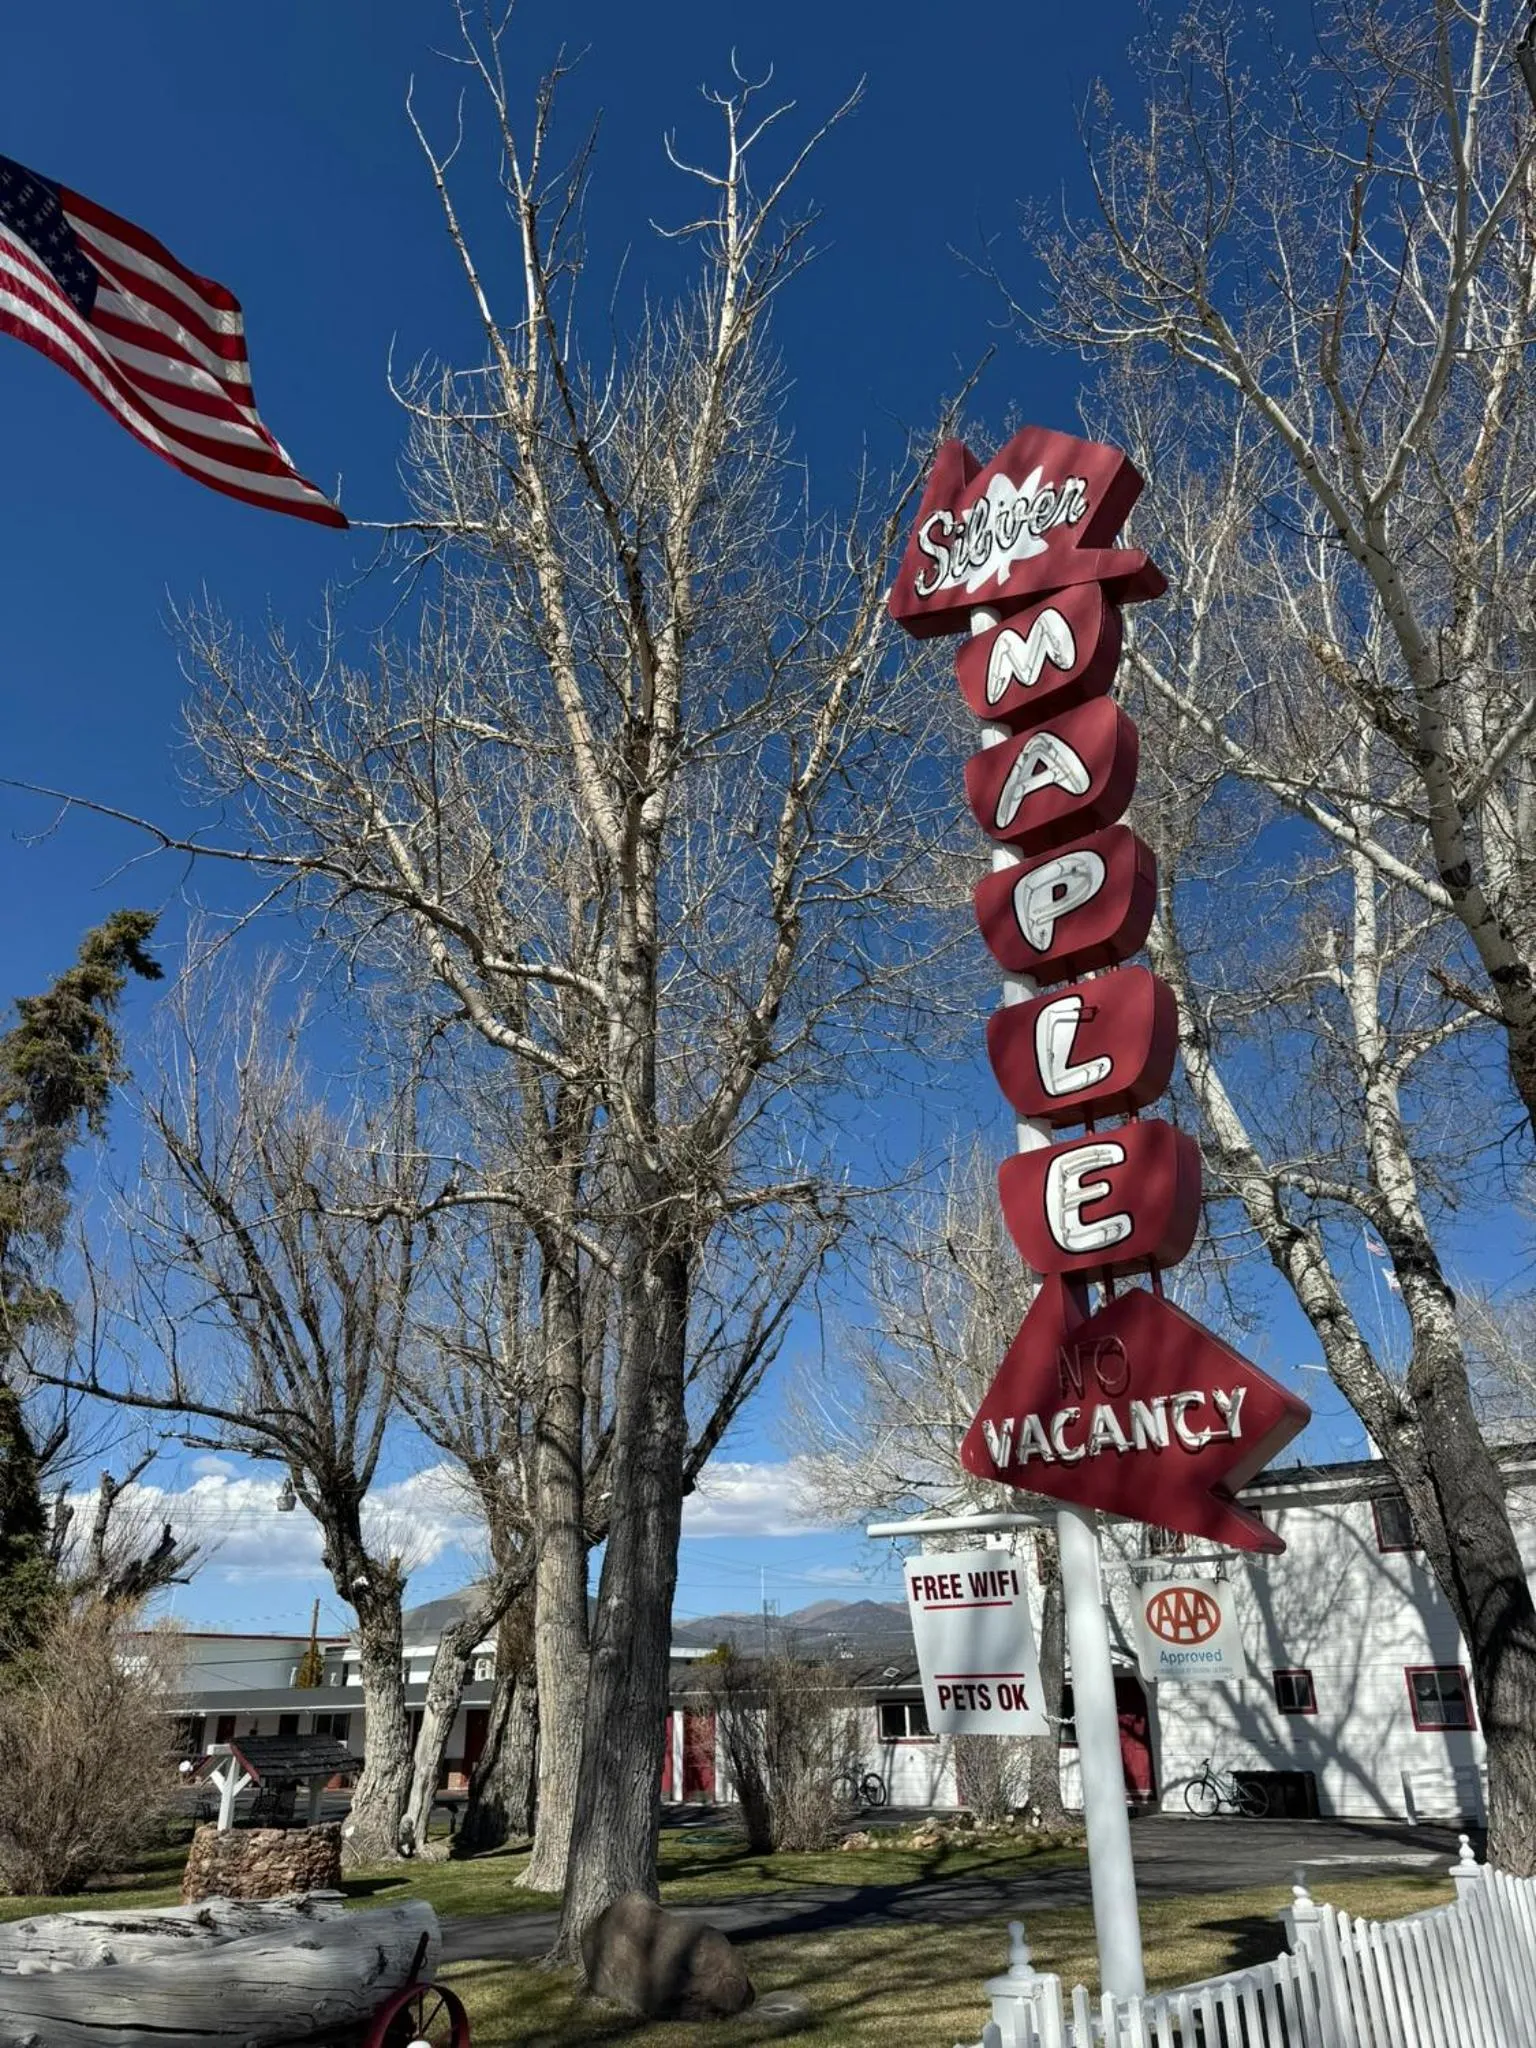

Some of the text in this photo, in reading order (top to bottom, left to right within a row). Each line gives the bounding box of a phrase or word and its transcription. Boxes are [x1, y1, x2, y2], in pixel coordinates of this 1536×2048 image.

[914, 475, 1088, 597] Silver
[986, 607, 1135, 1254] MAPLE
[1057, 1334, 1131, 1400] NO
[982, 1386, 1248, 1469] VACANCY
[911, 1570, 1019, 1601] FREE WIFI
[1157, 1591, 1215, 1639] AAA
[1160, 1649, 1223, 1665] Approved
[938, 1684, 1029, 1711] PETS OK
